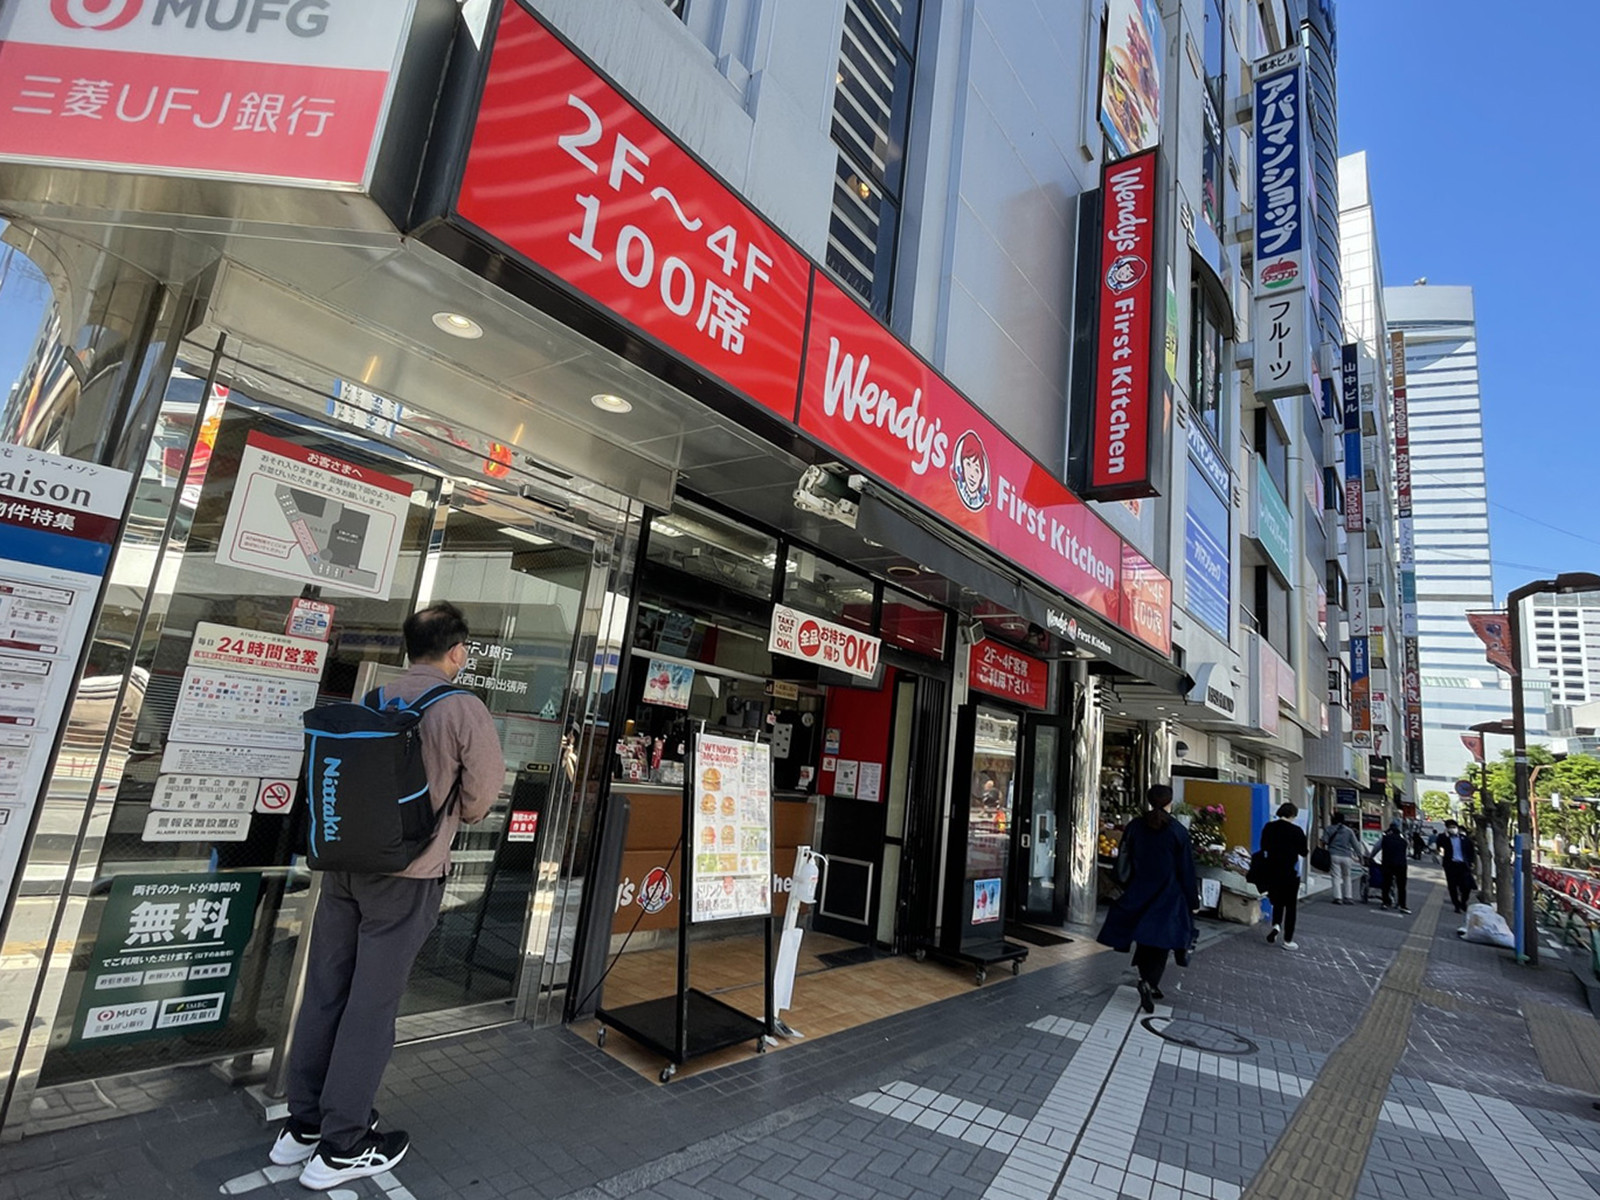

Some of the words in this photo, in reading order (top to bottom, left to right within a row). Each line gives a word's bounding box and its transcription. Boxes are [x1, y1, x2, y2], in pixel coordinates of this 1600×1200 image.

[151, 0, 331, 38] MUFG
[12, 75, 336, 137] 三菱UFJ銀行
[1261, 74, 1297, 253] アパマンショップ
[1107, 167, 1147, 252] Wendy's
[568, 193, 751, 355] 100席
[1112, 298, 1135, 361] First
[1269, 301, 1291, 381] フルーツ
[1344, 362, 1358, 414] 山中ビル
[1108, 365, 1132, 474] Kitchen
[1396, 397, 1408, 438] JOYSOUND
[27, 454, 98, 476] シャーメゾン
[307, 452, 363, 478] お客さまへ
[823, 337, 948, 475] Wendy's
[997, 475, 1046, 542] First
[1051, 518, 1115, 590] Kitchen
[1398, 453, 1411, 490] カラオケ
[0, 470, 92, 507] aison
[777, 615, 795, 627] TAKE
[1353, 586, 1363, 634] ラーメン
[776, 637, 793, 650] OK!
[778, 624, 793, 635] OUT
[1077, 627, 1091, 643] First
[1091, 634, 1112, 654] Kitchen
[217, 637, 318, 666] 24時間営業
[800, 629, 819, 646] 全品
[821, 626, 846, 646] お持ち
[844, 634, 877, 673] OK!
[823, 645, 840, 662] 帰り
[132, 882, 241, 896] 両行のカードが時間内
[124, 897, 231, 945] 無料
[116, 1008, 147, 1018] MUFG
[162, 1010, 216, 1024] 三井住友銀行
